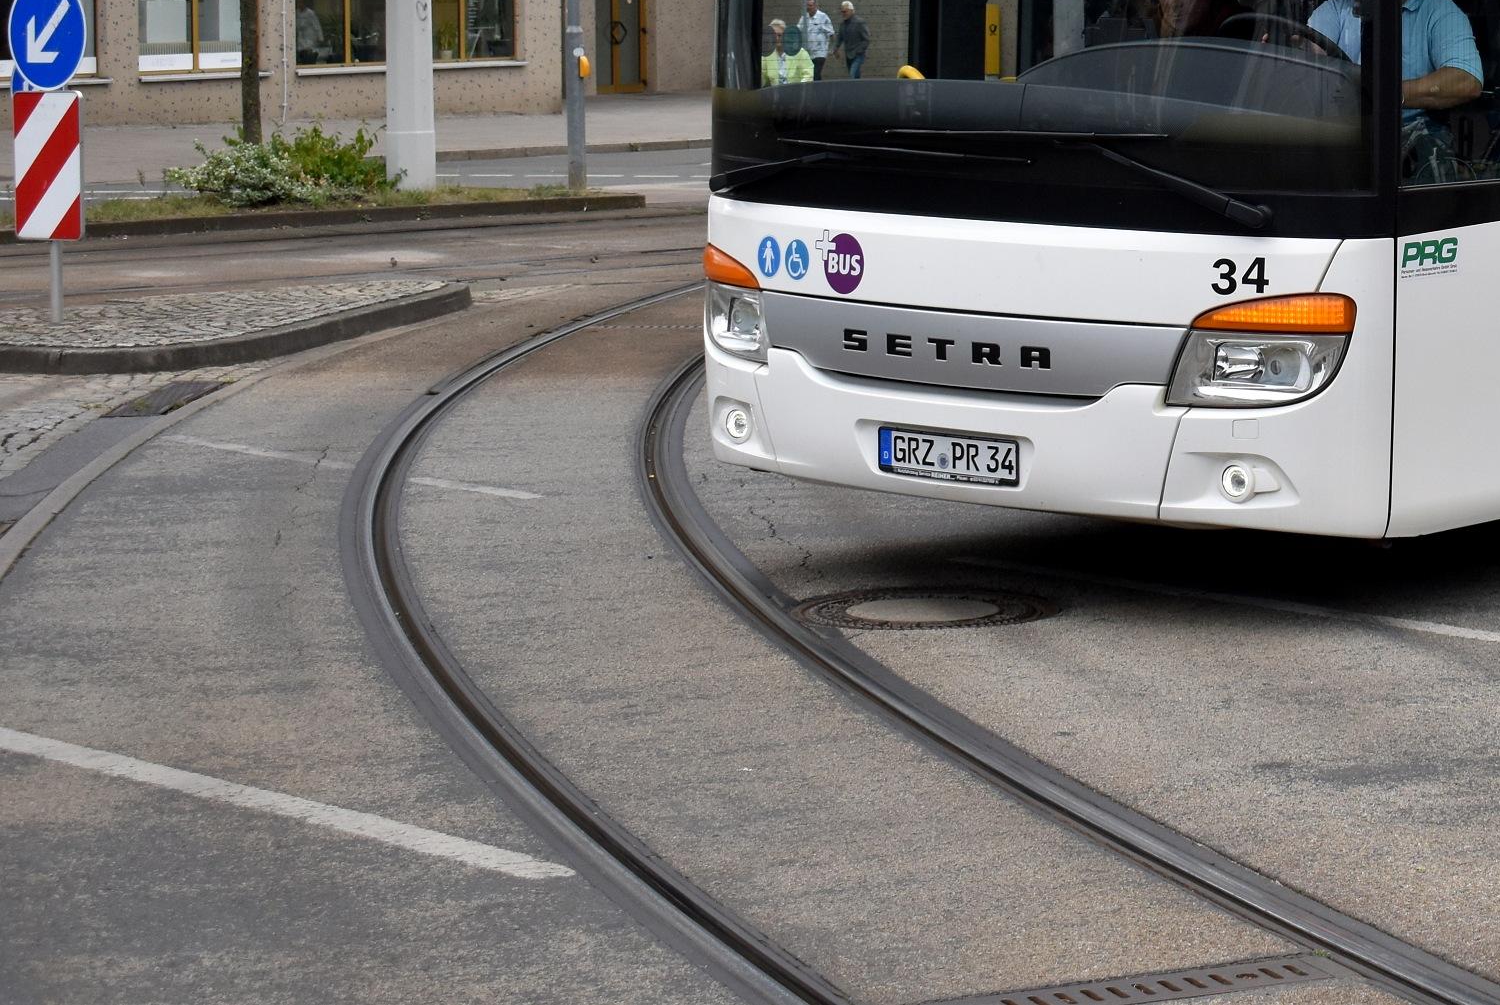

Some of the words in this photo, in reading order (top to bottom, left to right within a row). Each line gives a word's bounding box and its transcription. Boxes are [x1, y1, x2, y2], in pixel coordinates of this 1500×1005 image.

[828, 252, 861, 276] BUS
[1402, 237, 1458, 268] PRG
[1211, 257, 1269, 295] 34
[842, 327, 1052, 371] SETRA
[883, 450, 889, 459] D
[893, 435, 935, 466] GRZ
[951, 442, 979, 471] PR
[986, 446, 1014, 475] 34
